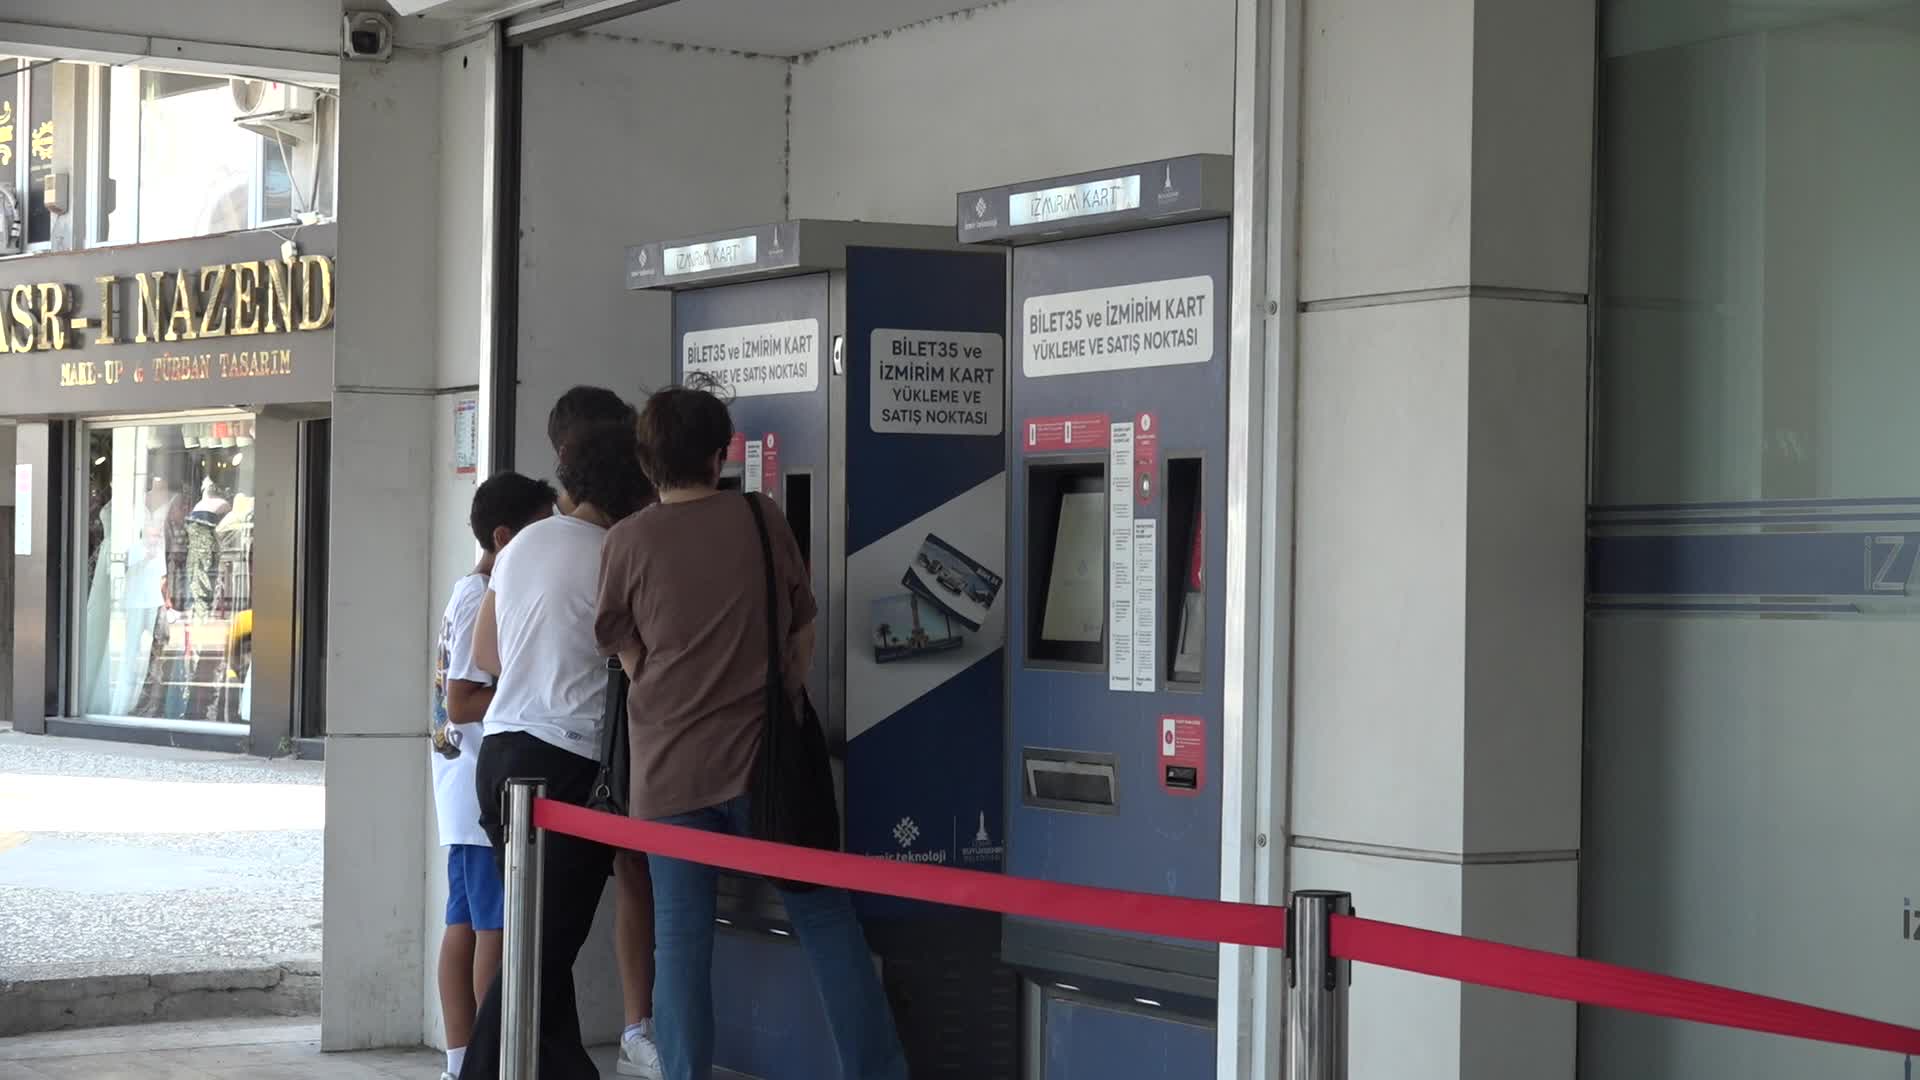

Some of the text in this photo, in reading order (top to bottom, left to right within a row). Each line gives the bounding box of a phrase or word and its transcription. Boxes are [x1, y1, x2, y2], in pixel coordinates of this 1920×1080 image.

[1082, 186, 1120, 209] KART
[714, 244, 740, 264] KART
[135, 255, 335, 343] NAZEND
[1030, 295, 1205, 334] BİLET35 ve İZMİRİM KART
[688, 334, 813, 364] BİLET35 ve İZMİRİM KART
[892, 336, 982, 358] BİLET35 ve
[1033, 328, 1198, 360] YÜKLEME VE SATIŞ NOKTASI
[152, 352, 212, 382] TÜRBAN
[218, 349, 292, 378] TASARIM
[729, 367, 741, 383] VE
[743, 365, 767, 384] SATIŞ
[769, 362, 807, 380] NOKTASI
[880, 360, 994, 384] İZMİRİM KART
[893, 386, 981, 404] YÜKLEME VE
[882, 409, 988, 425] SATIŞ NOKTASI
[897, 851, 946, 864] teknoloji
